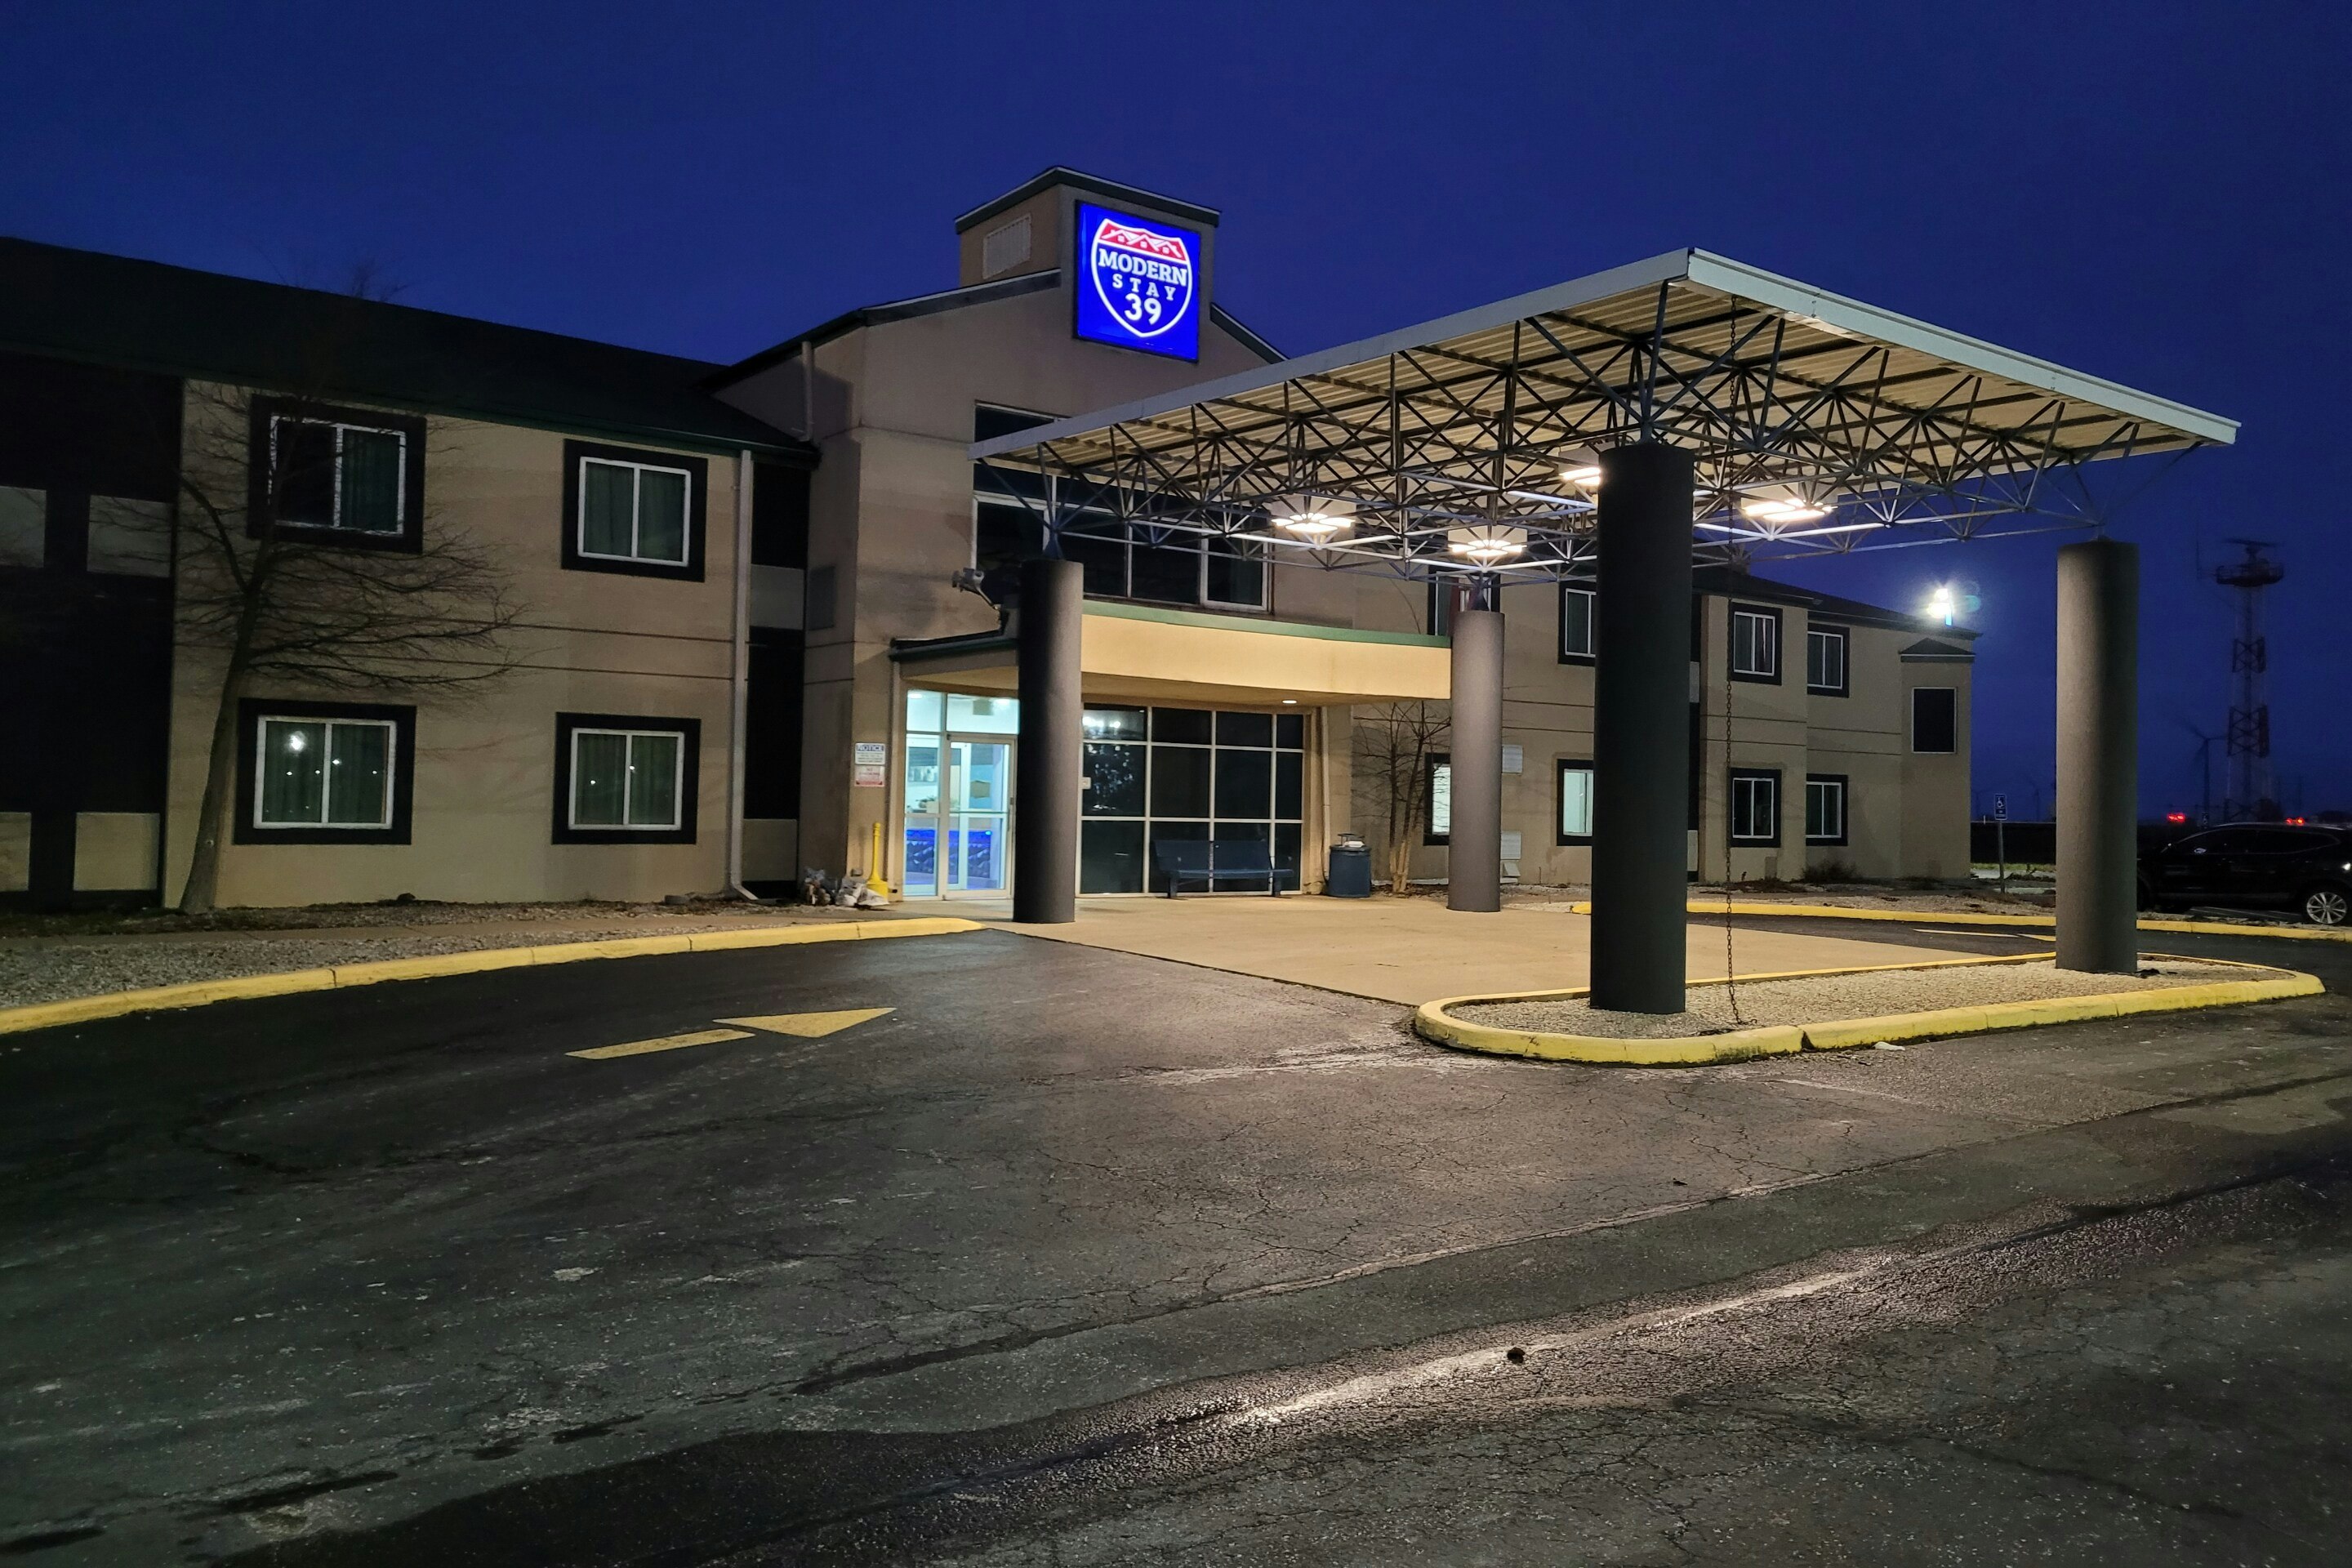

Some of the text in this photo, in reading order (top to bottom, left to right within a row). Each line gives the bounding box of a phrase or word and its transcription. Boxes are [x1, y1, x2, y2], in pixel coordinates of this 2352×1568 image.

[1098, 248, 1187, 287] MODERN
[1112, 274, 1176, 301] STAY
[1124, 293, 1162, 325] 39
